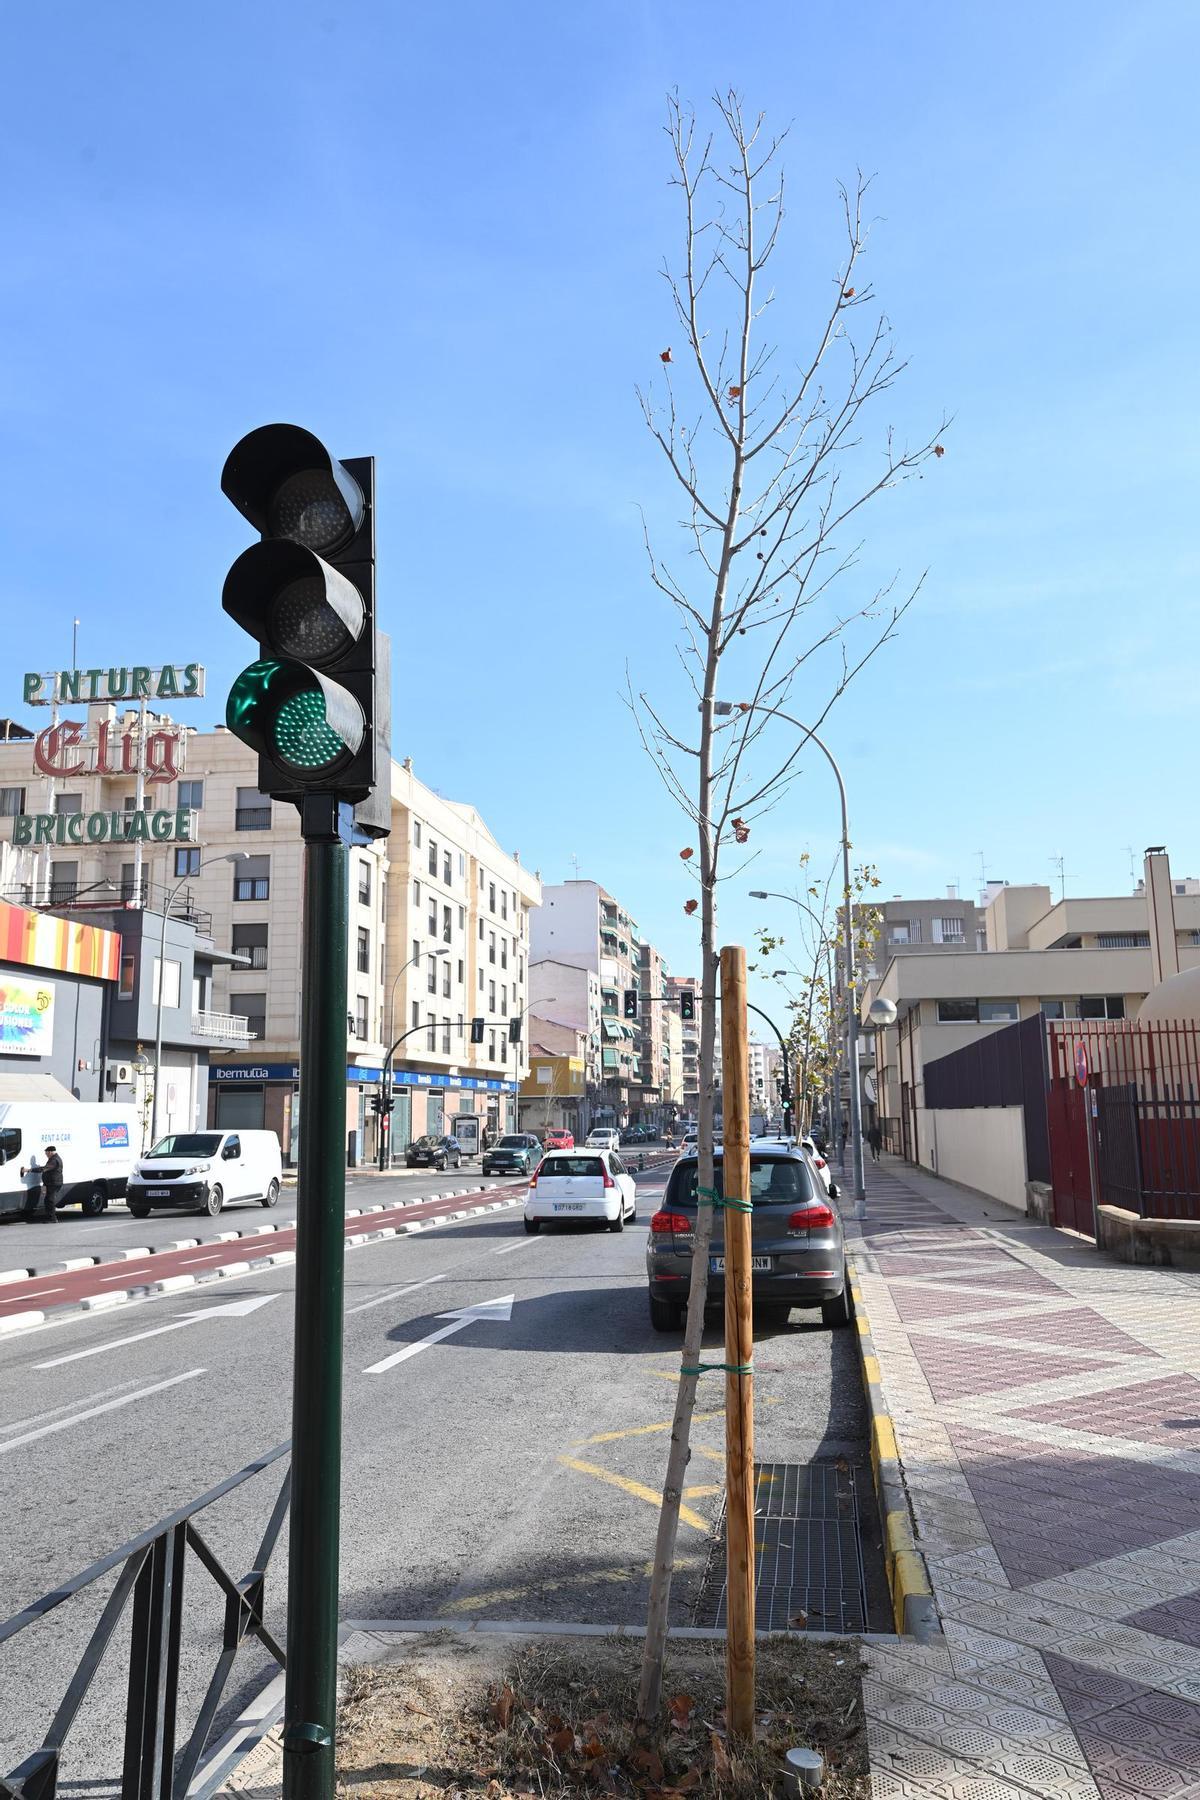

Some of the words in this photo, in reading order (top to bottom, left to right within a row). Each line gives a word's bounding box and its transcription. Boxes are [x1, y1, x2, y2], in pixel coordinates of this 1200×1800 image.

[23, 663, 199, 703] PNTURAS
[12, 808, 190, 846] BRICOLAGE
[216, 1067, 269, 1079] Ibermutua
[41, 1133, 55, 1143] RENT
[60, 1132, 72, 1142] CAR
